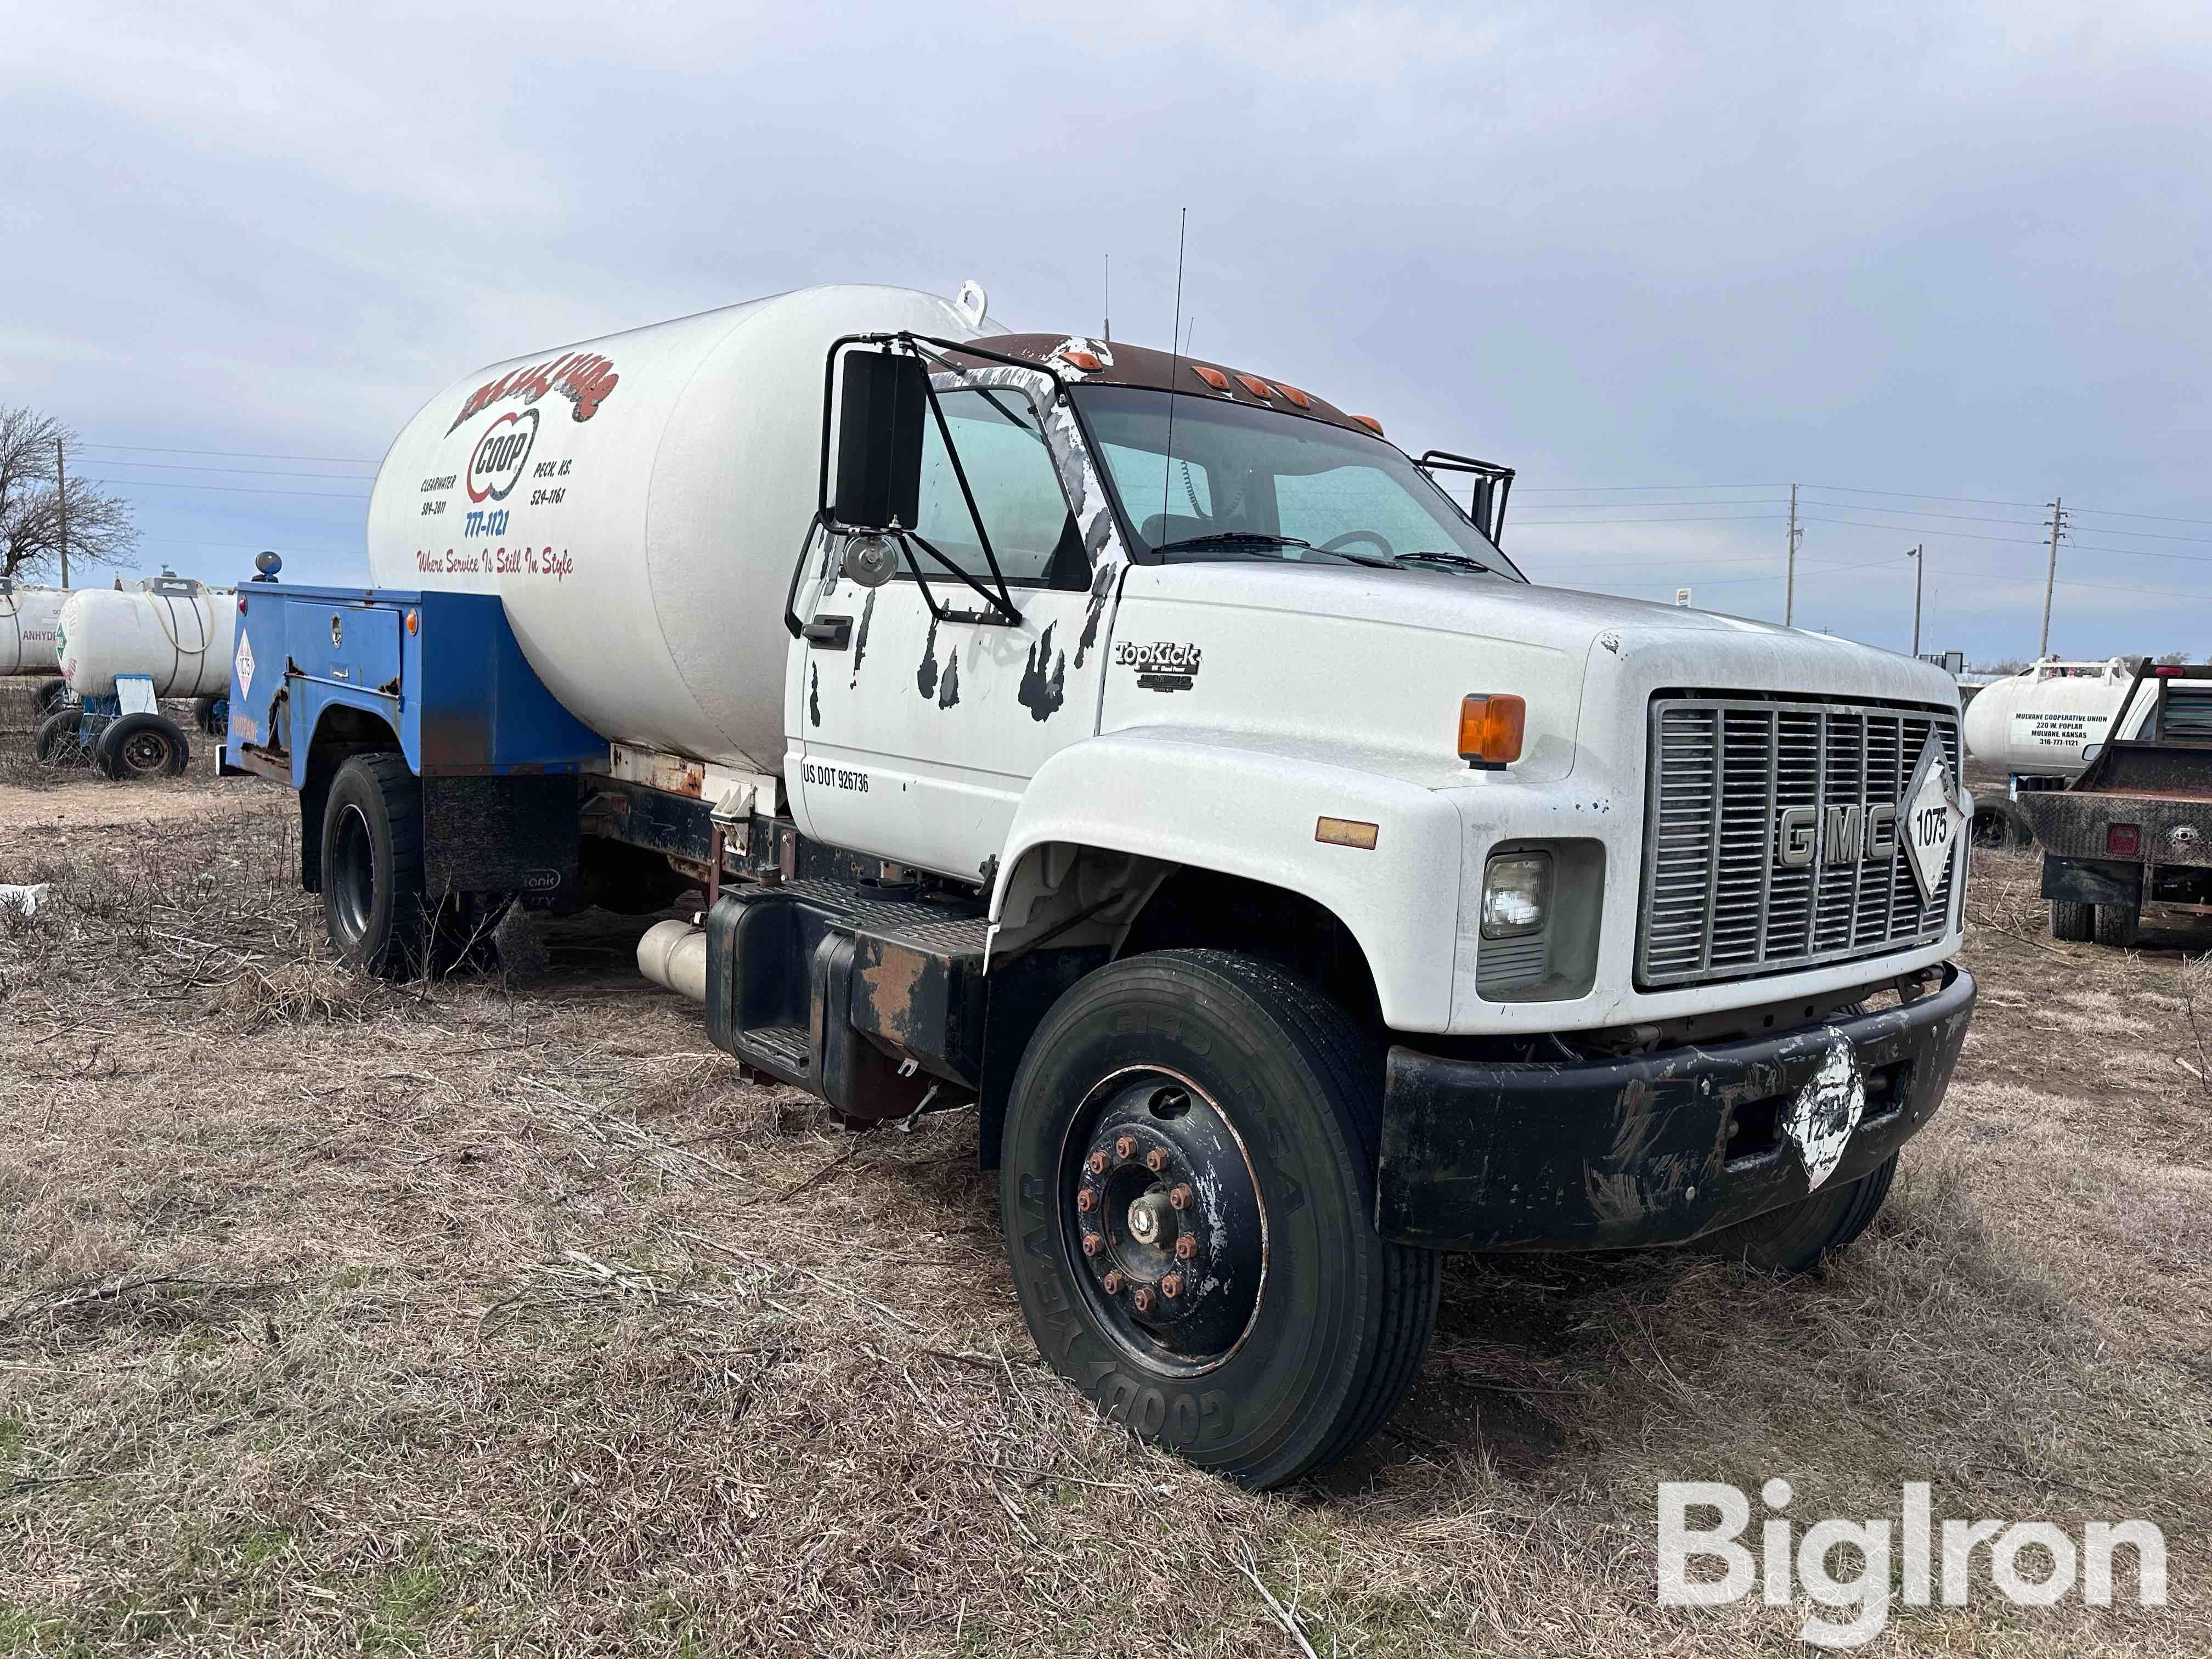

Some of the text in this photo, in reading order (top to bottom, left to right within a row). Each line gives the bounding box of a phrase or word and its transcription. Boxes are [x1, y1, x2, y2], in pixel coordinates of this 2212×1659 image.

[475, 433, 528, 475] COOP
[421, 475, 456, 492] CLEARWATER
[465, 509, 510, 538] 777-1121
[416, 546, 573, 584] Where Service Is Still In Style
[240, 658, 250, 676] 1075
[1115, 641, 1201, 672] TopKick
[803, 764, 868, 793] US DOT 926736
[1778, 803, 1896, 868] GMC
[1917, 806, 1948, 847] 1075
